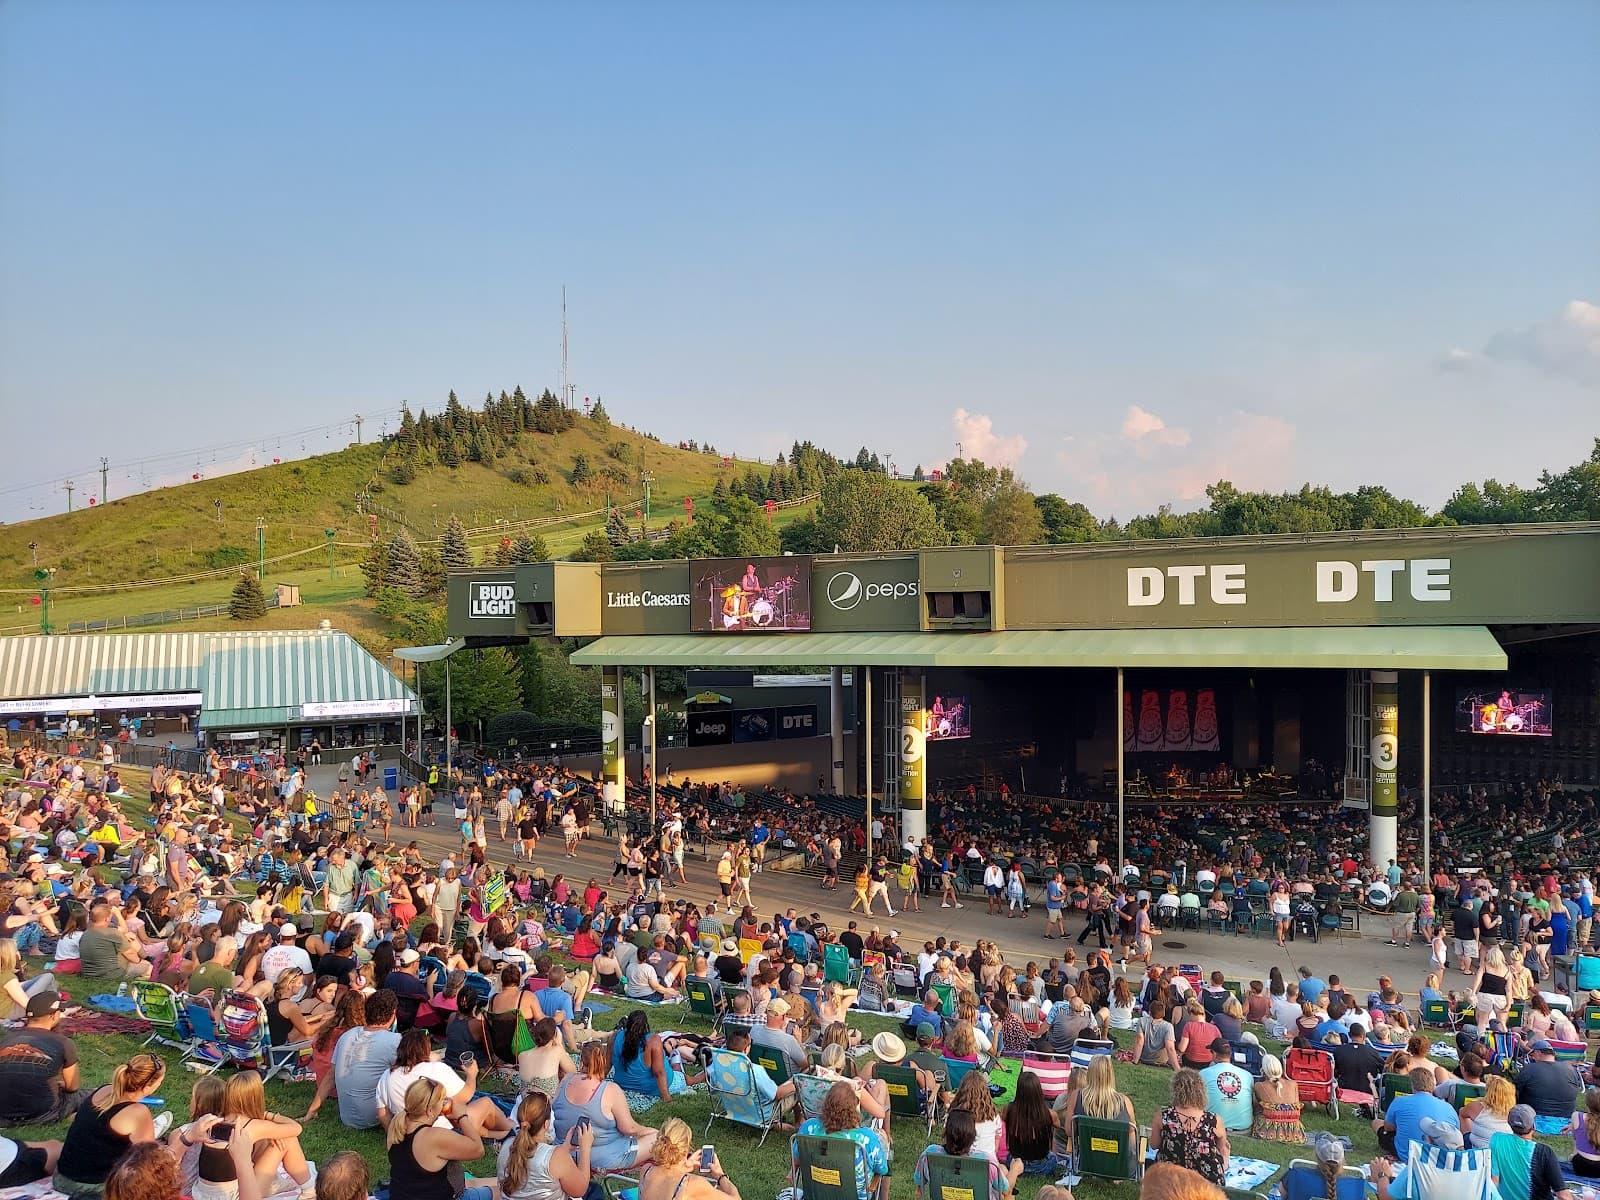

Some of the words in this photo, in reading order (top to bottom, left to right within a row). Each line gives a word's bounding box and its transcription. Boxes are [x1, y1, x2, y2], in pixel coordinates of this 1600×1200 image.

[866, 580, 920, 600] pepsi
[1127, 564, 1247, 606] DTE
[1316, 559, 1451, 602] DTE
[479, 586, 514, 600] BUD
[607, 591, 640, 607] Little
[641, 590, 690, 606] Caesars
[695, 722, 726, 735] Jeep
[783, 714, 813, 729] DTE
[903, 734, 914, 754] 2
[1380, 742, 1393, 762] 3
